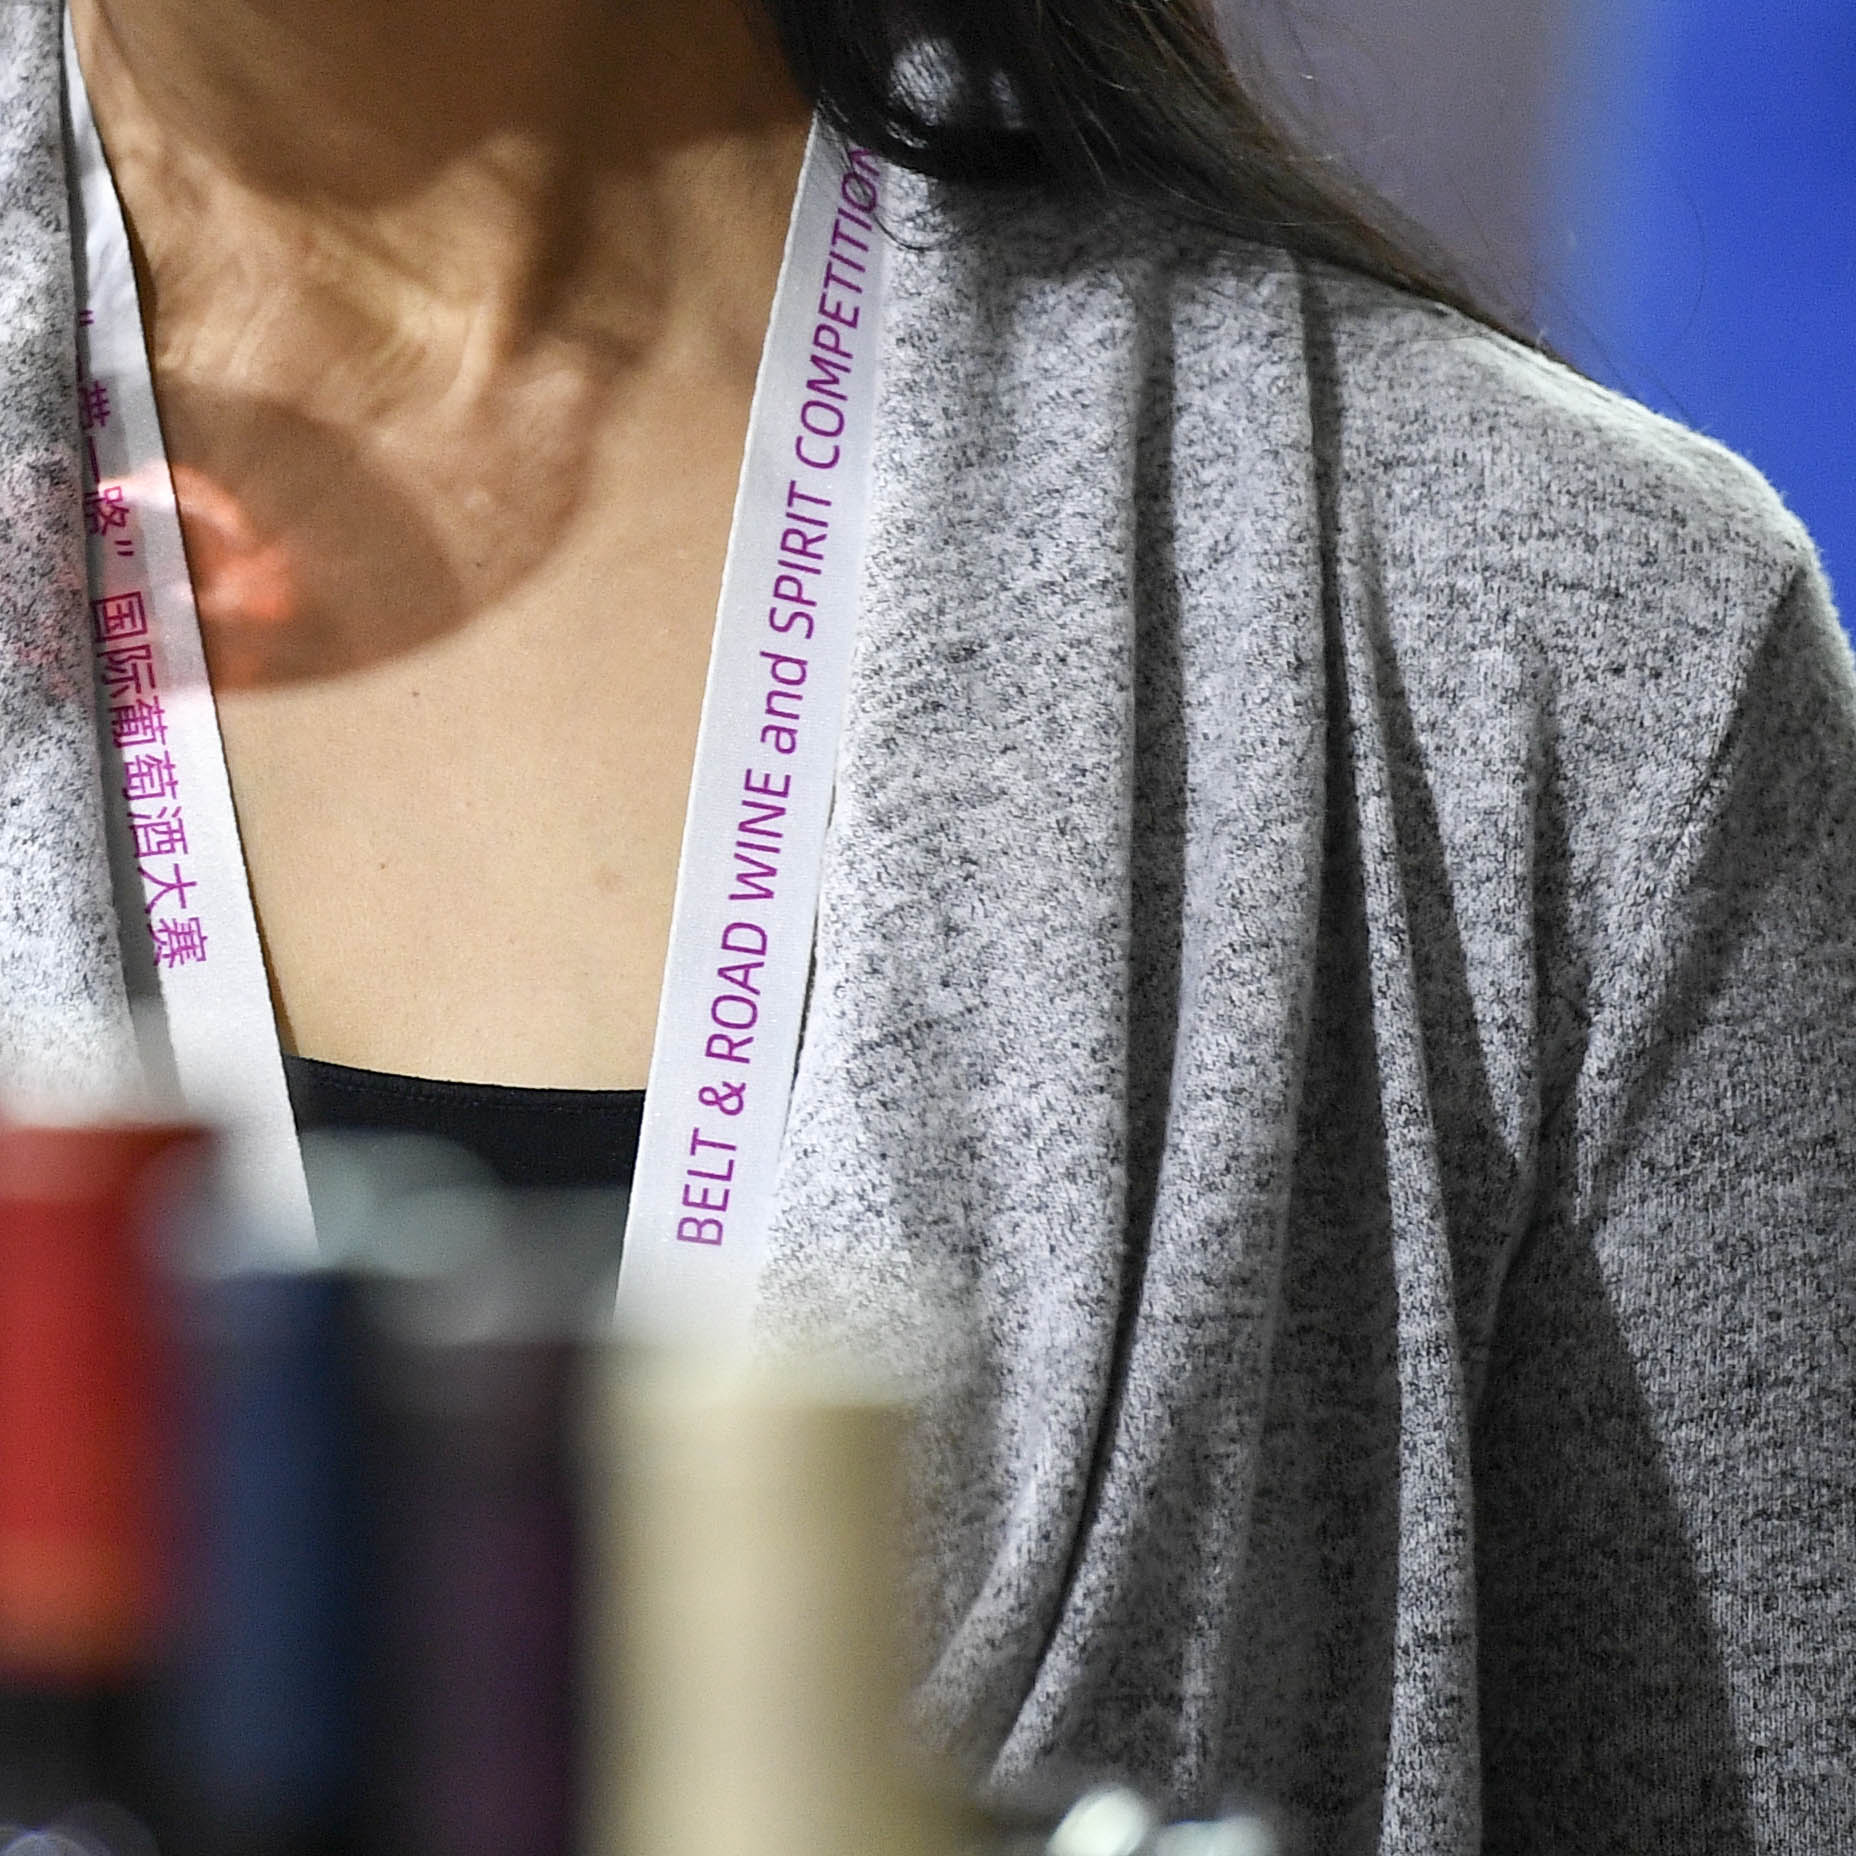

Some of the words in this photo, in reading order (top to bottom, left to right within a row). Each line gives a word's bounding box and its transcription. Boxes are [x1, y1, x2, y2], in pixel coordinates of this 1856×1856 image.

[795, 146, 881, 471] COMPETITION
[768, 479, 833, 642] SPIRIT
[759, 650, 809, 757] and
[727, 767, 792, 902] WINE
[704, 921, 769, 1065] ROAD
[697, 1080, 748, 1118] &
[677, 1126, 737, 1247] BELT
